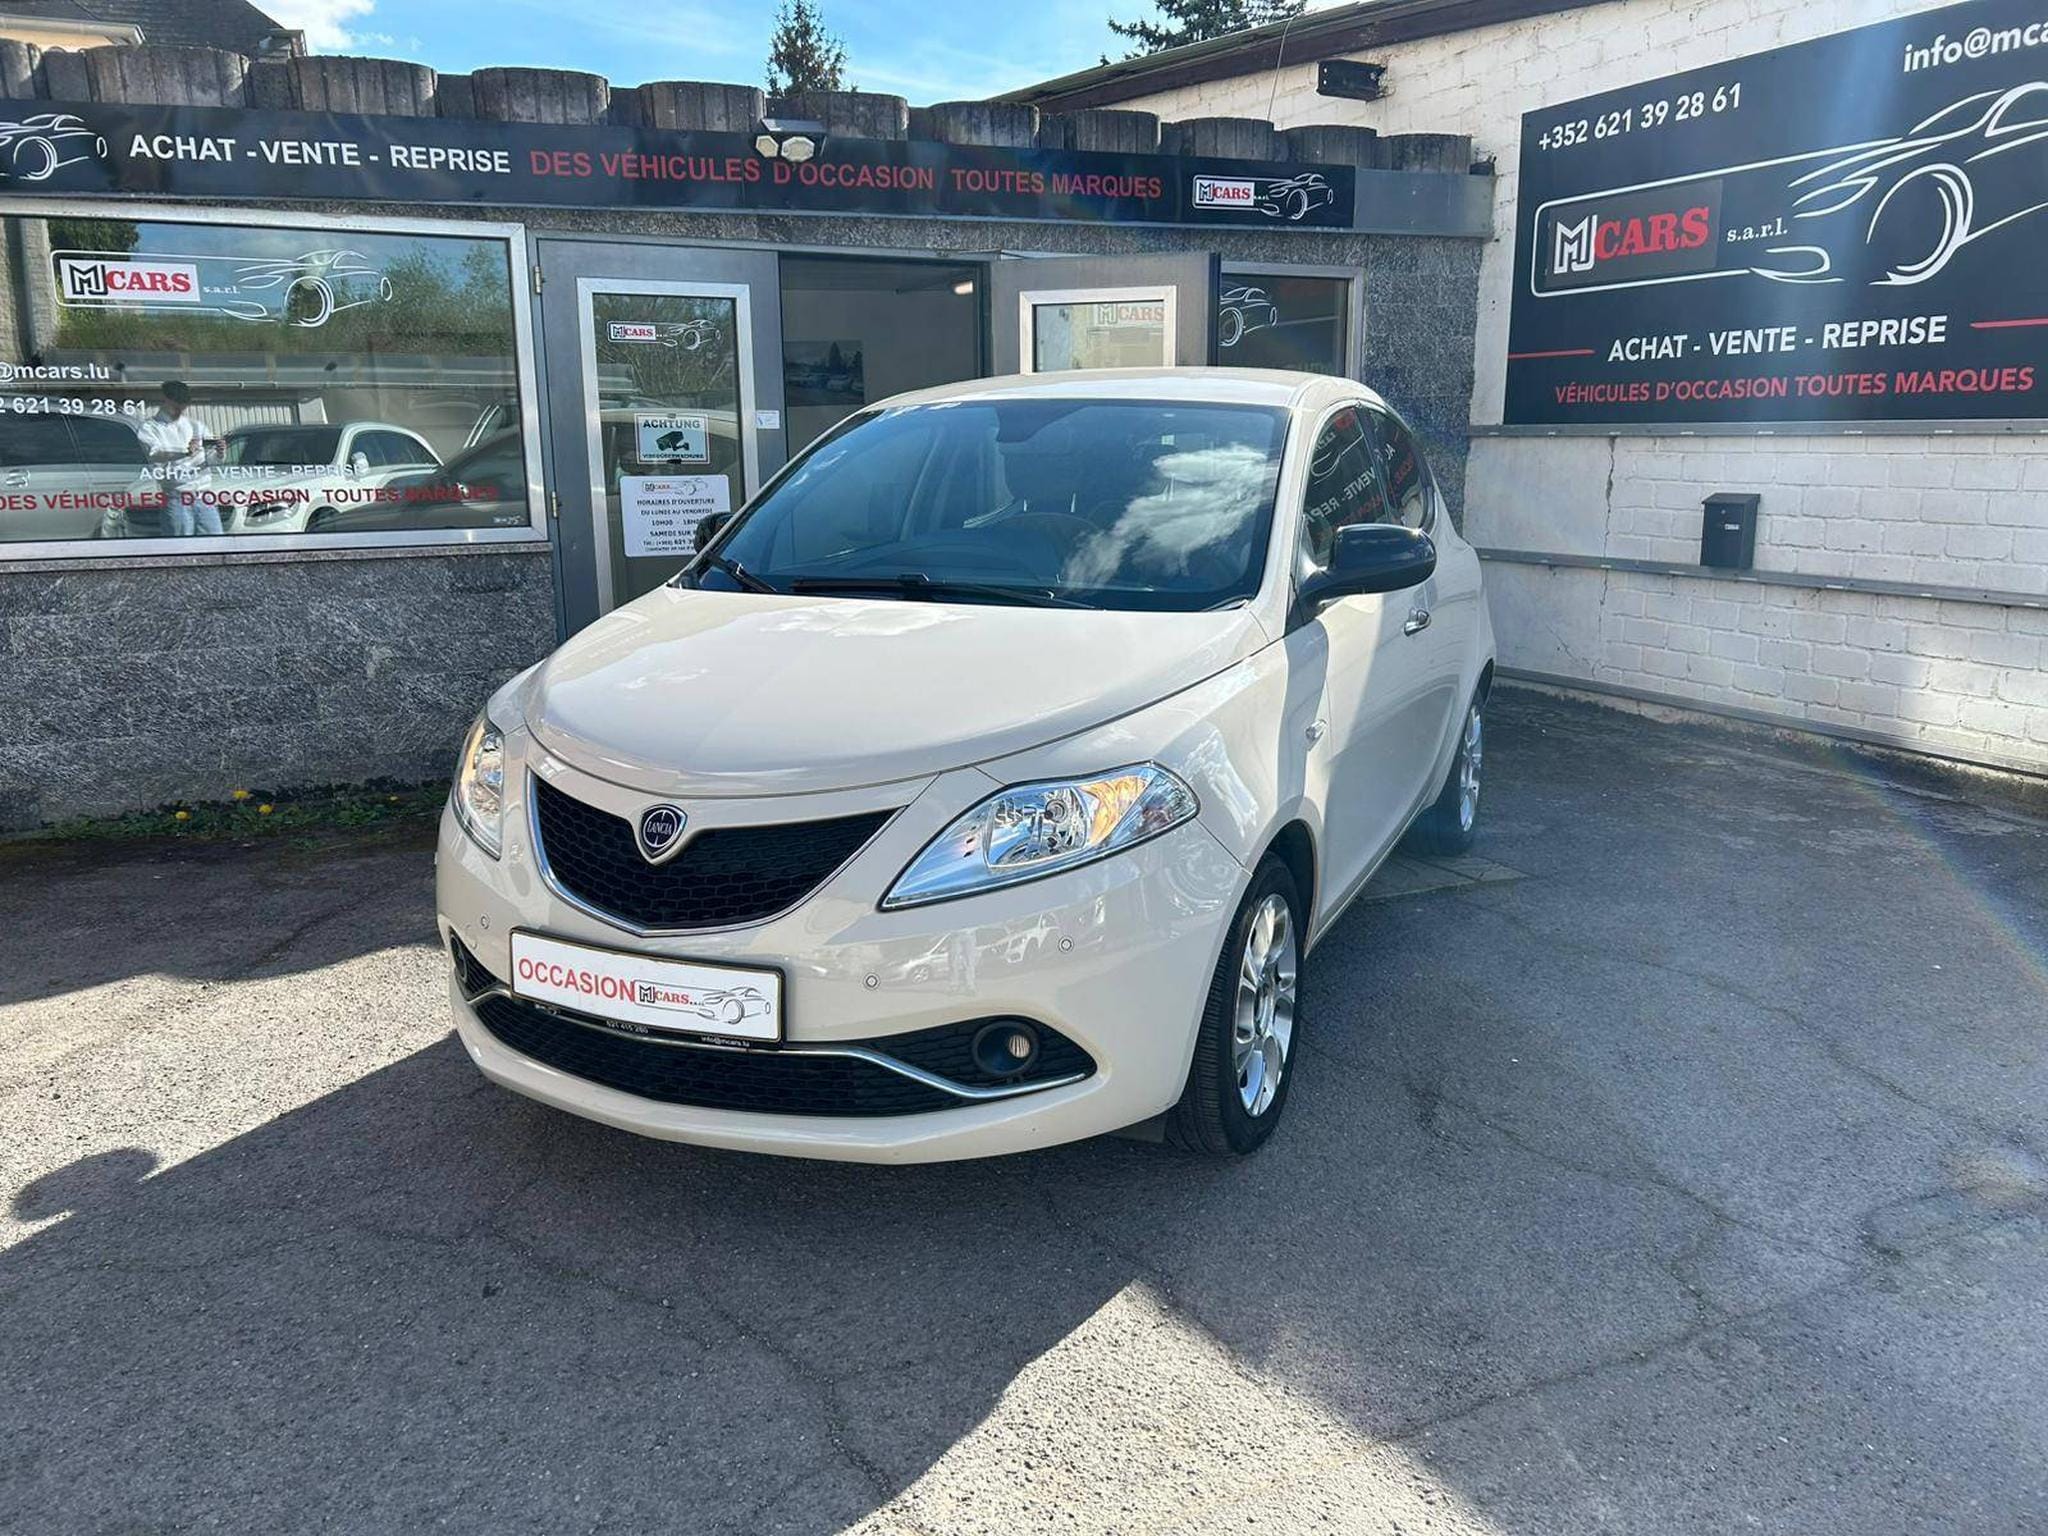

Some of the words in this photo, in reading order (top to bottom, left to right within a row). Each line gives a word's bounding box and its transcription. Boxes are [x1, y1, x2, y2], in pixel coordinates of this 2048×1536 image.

[1539, 119, 1588, 151] +352
[1594, 108, 1632, 139] 621
[1640, 100, 1669, 129] 39
[1675, 91, 1705, 122] 28
[1712, 82, 1741, 113] 61
[129, 134, 236, 163] ACHAT
[390, 146, 511, 174] REPRISE
[529, 150, 593, 178] DES
[601, 146, 760, 183] VÉHICULES
[773, 161, 933, 191] D'OCCASION
[951, 168, 1045, 195] TOUTES
[1052, 173, 1161, 199] MARQUES
[1727, 218, 1788, 242] s.a.r.l.
[1607, 334, 1688, 362] ACHAT
[1709, 326, 1797, 356] VENTE
[1822, 315, 1948, 349] REPRISE
[1556, 381, 1650, 404] VÉHICULES
[1795, 371, 1888, 397] TOUTES
[1894, 366, 2035, 394] MARQUES
[13, 397, 51, 415] 621
[59, 398, 84, 415] 39
[91, 399, 117, 416] 28
[123, 400, 146, 416] 61
[643, 419, 700, 429] ACHTUNG
[139, 466, 201, 481] ACHAT
[216, 465, 276, 480] VENTE
[43, 491, 168, 510] VÉHICULES
[180, 488, 309, 507] D'OCCASION
[322, 487, 400, 504] TOUTES
[518, 958, 635, 1003] OCCASION
